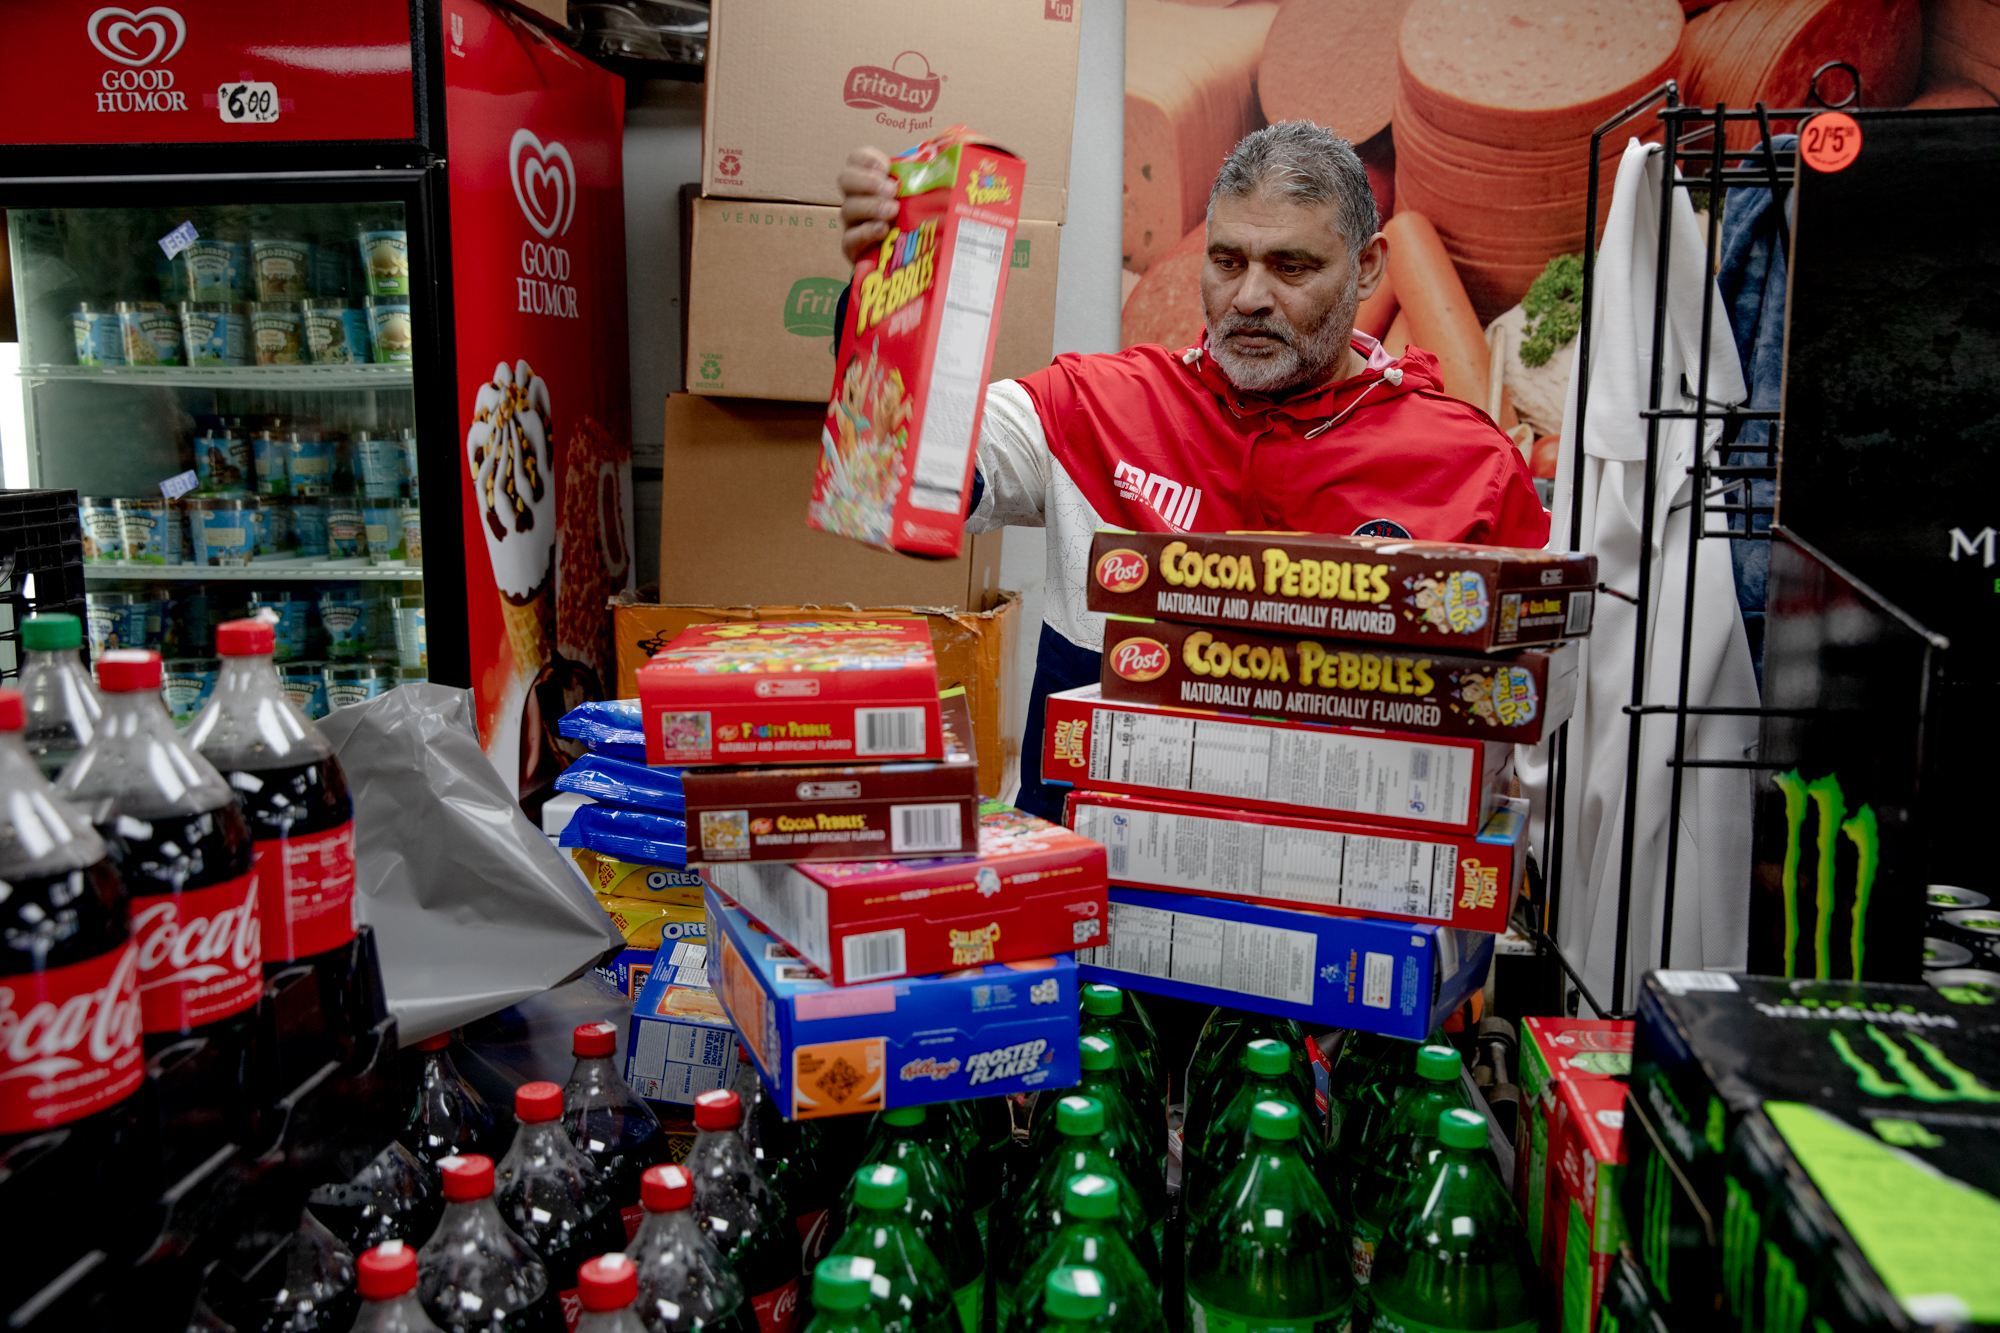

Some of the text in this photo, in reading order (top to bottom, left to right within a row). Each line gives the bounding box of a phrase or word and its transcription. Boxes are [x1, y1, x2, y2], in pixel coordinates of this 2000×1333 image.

[102, 69, 175, 90] GOOD
[95, 91, 189, 112] HUMOR
[875, 112, 933, 133] Good fun!
[718, 148, 744, 156] PLEASE
[714, 178, 744, 186] RECYCLE
[722, 212, 838, 229] VENDING &
[165, 226, 191, 253] EBT
[521, 240, 570, 282] GOOD
[516, 276, 580, 320] HUMOR
[856, 245, 935, 338] PEBBLES
[165, 475, 193, 497] EBT
[1103, 541, 1390, 604] Post COCOA PEBBLES
[1157, 591, 1396, 635] NATURALLY AND ARTIFICIALLY FLAVORED
[1119, 631, 1435, 697] Post COCOA PEBBLES
[1181, 680, 1441, 727] NATURALLY AND ARTIFICIALLY FLAVORED
[787, 720, 832, 738] PEBBLES
[1054, 719, 1072, 759] Lucky
[719, 738, 852, 753] NATURALLY AND ARTIFICIALLY FLAVORED
[1069, 718, 1088, 768] Charms
[1090, 738, 1098, 778] Nutrition
[776, 815, 816, 832] COCOA
[816, 813, 865, 830] PEBBLES
[756, 829, 885, 846] NATURALLY AND ARTIFICIALLY FLAVORED
[648, 872, 702, 889] OREO
[1411, 880, 1419, 894] 140
[1444, 847, 1456, 918] Nutrition Facts
[1458, 858, 1481, 910] Charms
[1477, 867, 1499, 909] Lucky
[663, 923, 706, 939] ORE
[949, 922, 1001, 948] Charms
[952, 940, 995, 965] Lucky
[703, 1030, 714, 1065] HEATING
[711, 1045, 719, 1066] BEFORE
[965, 1038, 1047, 1072] FROSTED
[900, 1056, 961, 1081] Kellogg's
[969, 1055, 1039, 1086] FLAKES
